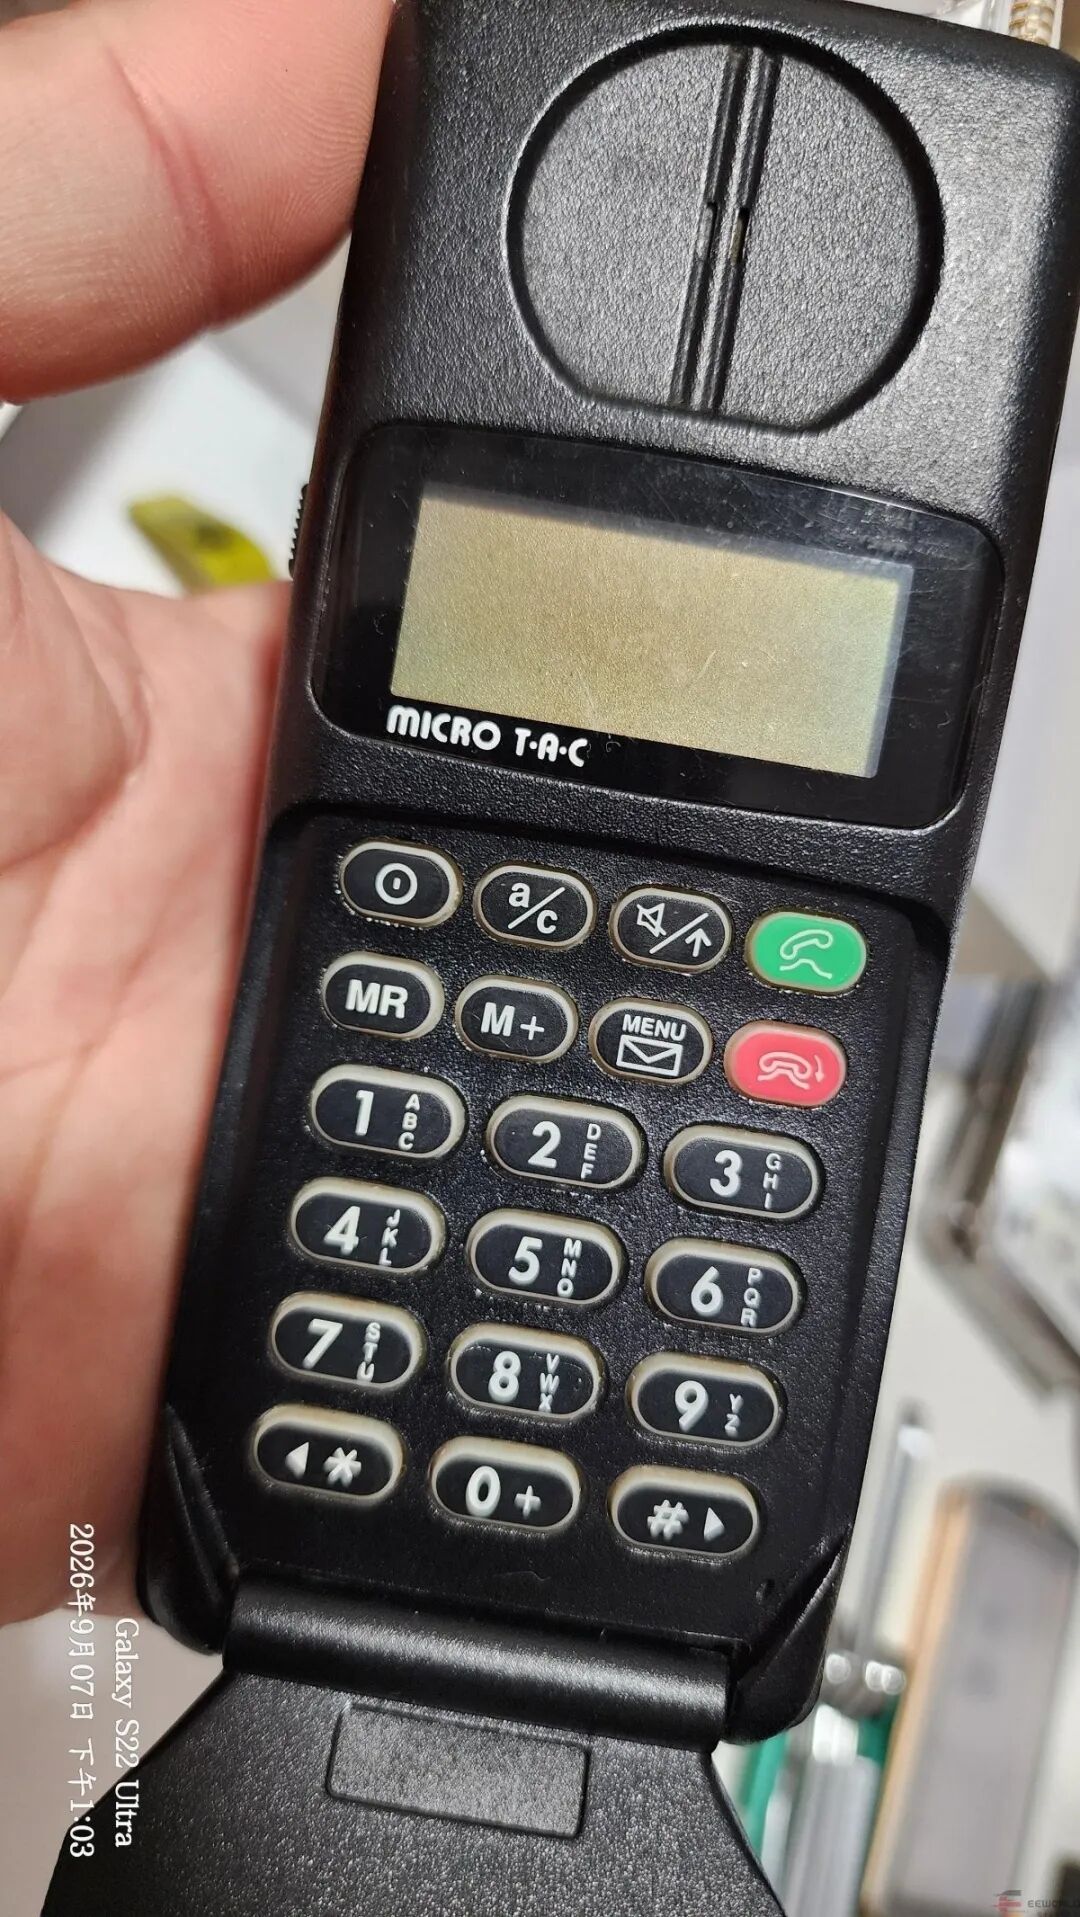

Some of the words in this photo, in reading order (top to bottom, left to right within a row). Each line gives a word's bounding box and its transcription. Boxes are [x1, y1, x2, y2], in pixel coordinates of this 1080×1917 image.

[388, 704, 501, 750] MICRO
[346, 980, 408, 1018] MR
[622, 1014, 687, 1041] MENU
[355, 1090, 374, 1136] 1
[528, 1121, 561, 1168] 2
[709, 1150, 742, 1197] 3
[324, 1206, 360, 1255] 4
[508, 1236, 543, 1287] 5
[690, 1266, 723, 1316] 6
[303, 1319, 343, 1369] 7
[488, 1351, 520, 1401] 8
[674, 1380, 708, 1431] 9
